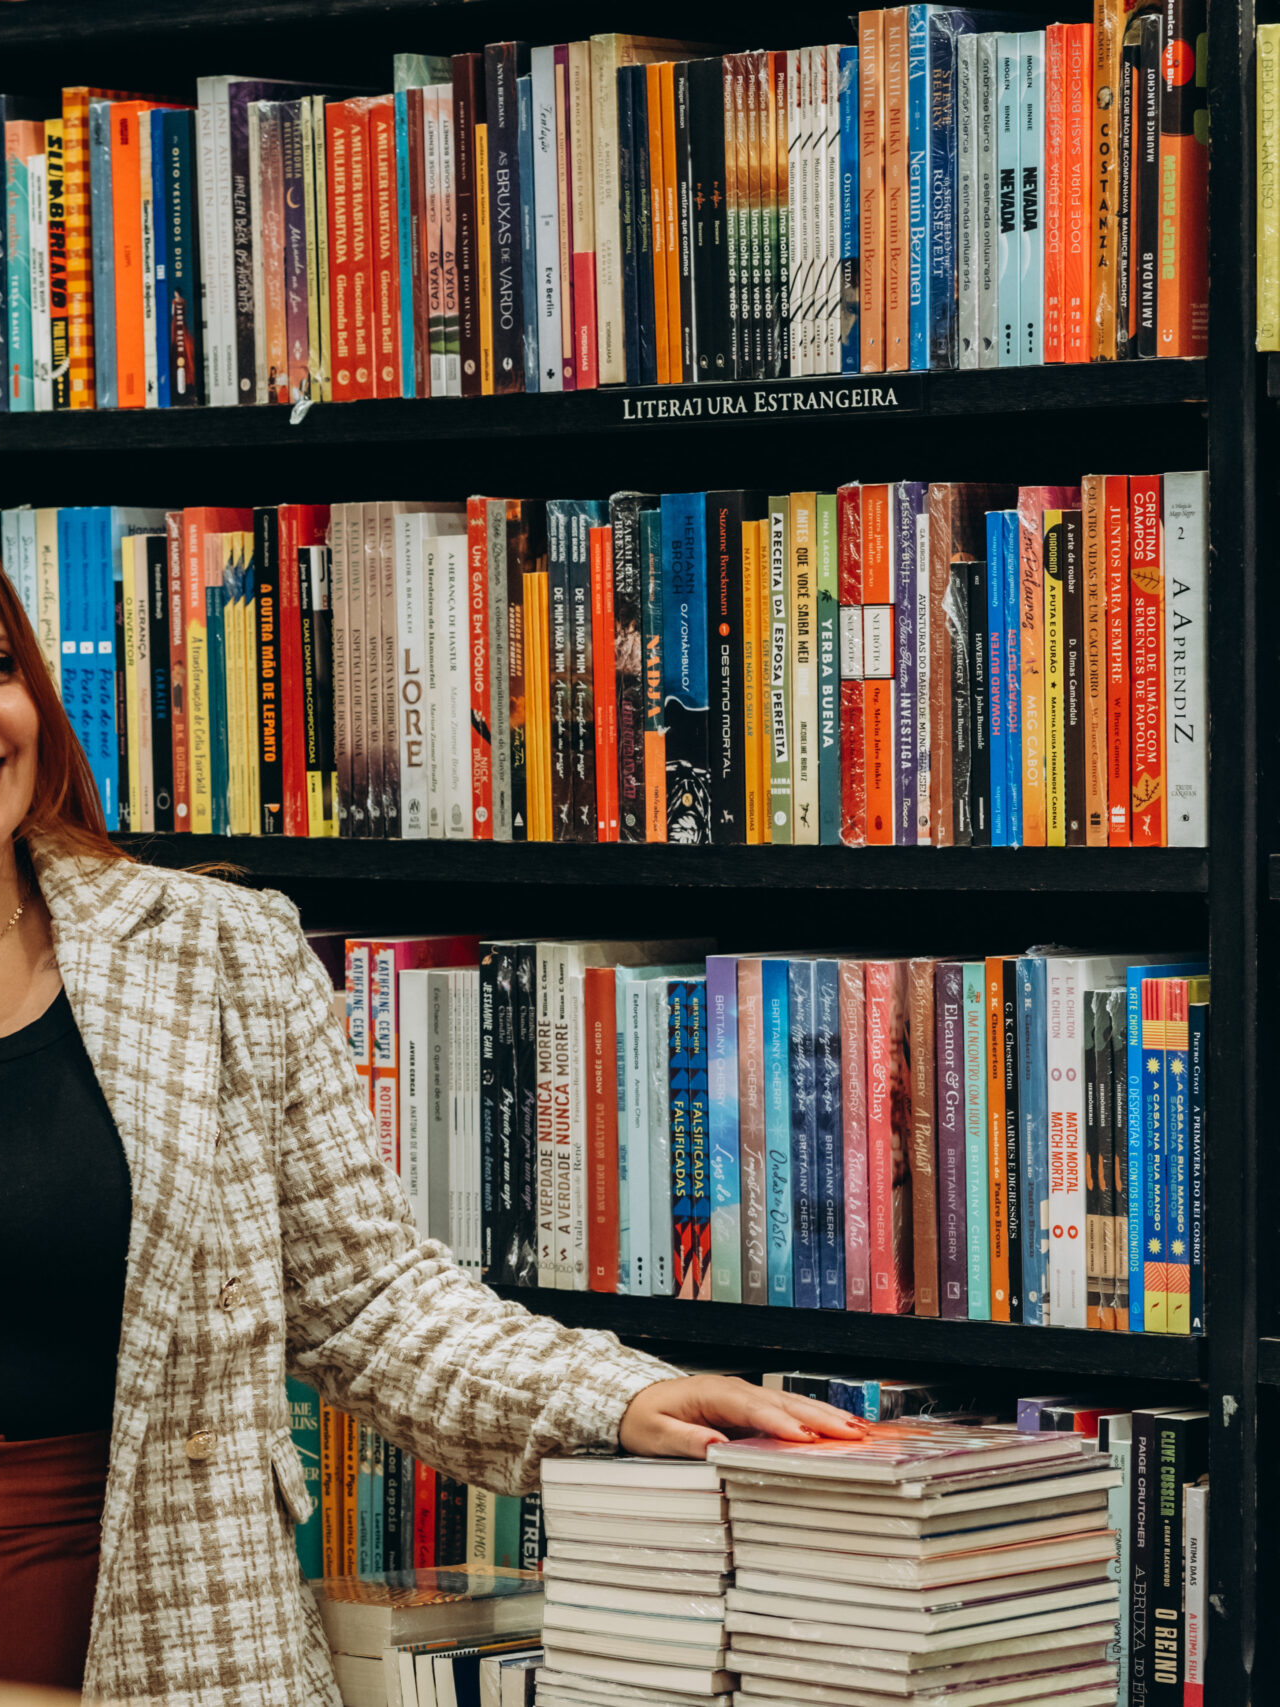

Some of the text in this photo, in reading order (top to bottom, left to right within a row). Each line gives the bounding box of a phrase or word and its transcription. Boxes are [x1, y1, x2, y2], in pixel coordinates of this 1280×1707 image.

[47, 135, 67, 309] SLUMBERLAND
[172, 148, 182, 278] OITO VESTIDOS DIOR
[333, 127, 346, 264] A MULHER HABITADA
[377, 121, 390, 259] A MULHER HABITADA
[910, 150, 925, 306] Nermin Bezmen
[1001, 168, 1015, 234] NEVADA
[1023, 167, 1038, 232] NEVADA
[1162, 155, 1176, 280] Mary Jane
[430, 251, 440, 310] CAIXA 19
[446, 251, 456, 310] CAIXA 19
[496, 151, 513, 330] AS BRUXAS DE VARDO
[337, 274, 348, 358] Gioconda Belli
[381, 270, 392, 354] Gioconda Belli
[545, 267, 554, 317] Eve Berlin
[1142, 253, 1154, 328] AMINADAB
[754, 387, 899, 413] ESTRANGEIRA
[719, 508, 729, 616] Suzanne Brockmann
[1134, 492, 1144, 560] CAMPOS
[1145, 491, 1156, 561] CRISTINA
[472, 545, 485, 693] UM GATO EM TÓQUIO
[1110, 506, 1122, 684] JUNTOS PARA SEMPRE
[1172, 578, 1191, 599] A
[260, 584, 276, 763] A OUTRA MÃO DE LEPANTO
[647, 634, 661, 718] NADJA
[772, 517, 786, 758] A RECEITA DA ESPOSA PERFEITA
[821, 618, 834, 748] YERBA BUENA
[1134, 598, 1146, 772] SEMENTES DE PAPOULA
[1146, 606, 1158, 763] BOLO DE LIMÃO COM
[303, 619, 316, 764] DUAS DAMAS BEM-COMPORTADAS
[721, 644, 731, 778] DESTINO MORTAL
[900, 692, 911, 769] INVESTIGA
[1026, 695, 1038, 787] MEG CABOT
[377, 960, 391, 1060] KATHERINE CENTER
[870, 997, 886, 1123] Landon & Shay
[942, 1003, 959, 1131] Eleanor & Grey
[1152, 1081, 1160, 1090] A
[555, 1023, 570, 1234] A VERDADE NUNCA MORRE
[674, 1101, 686, 1197] FALSIFICADAS
[691, 1101, 705, 1198] FALSIFICADAS
[1066, 1112, 1079, 1195] MATCH MORTAL
[1152, 1094, 1160, 1129] CASA
[1153, 1132, 1160, 1150] NA
[825, 1135, 835, 1247] BRITTAINY CHERRY
[1153, 1183, 1161, 1231] MANGO
[1137, 1436, 1146, 1547] PAIGE CRUTCHER
[1161, 1431, 1175, 1516] CLIVE CUSSLER
[1189, 1538, 1197, 1586] FATIMA DAAS
[1155, 1608, 1177, 1684] O REINO
